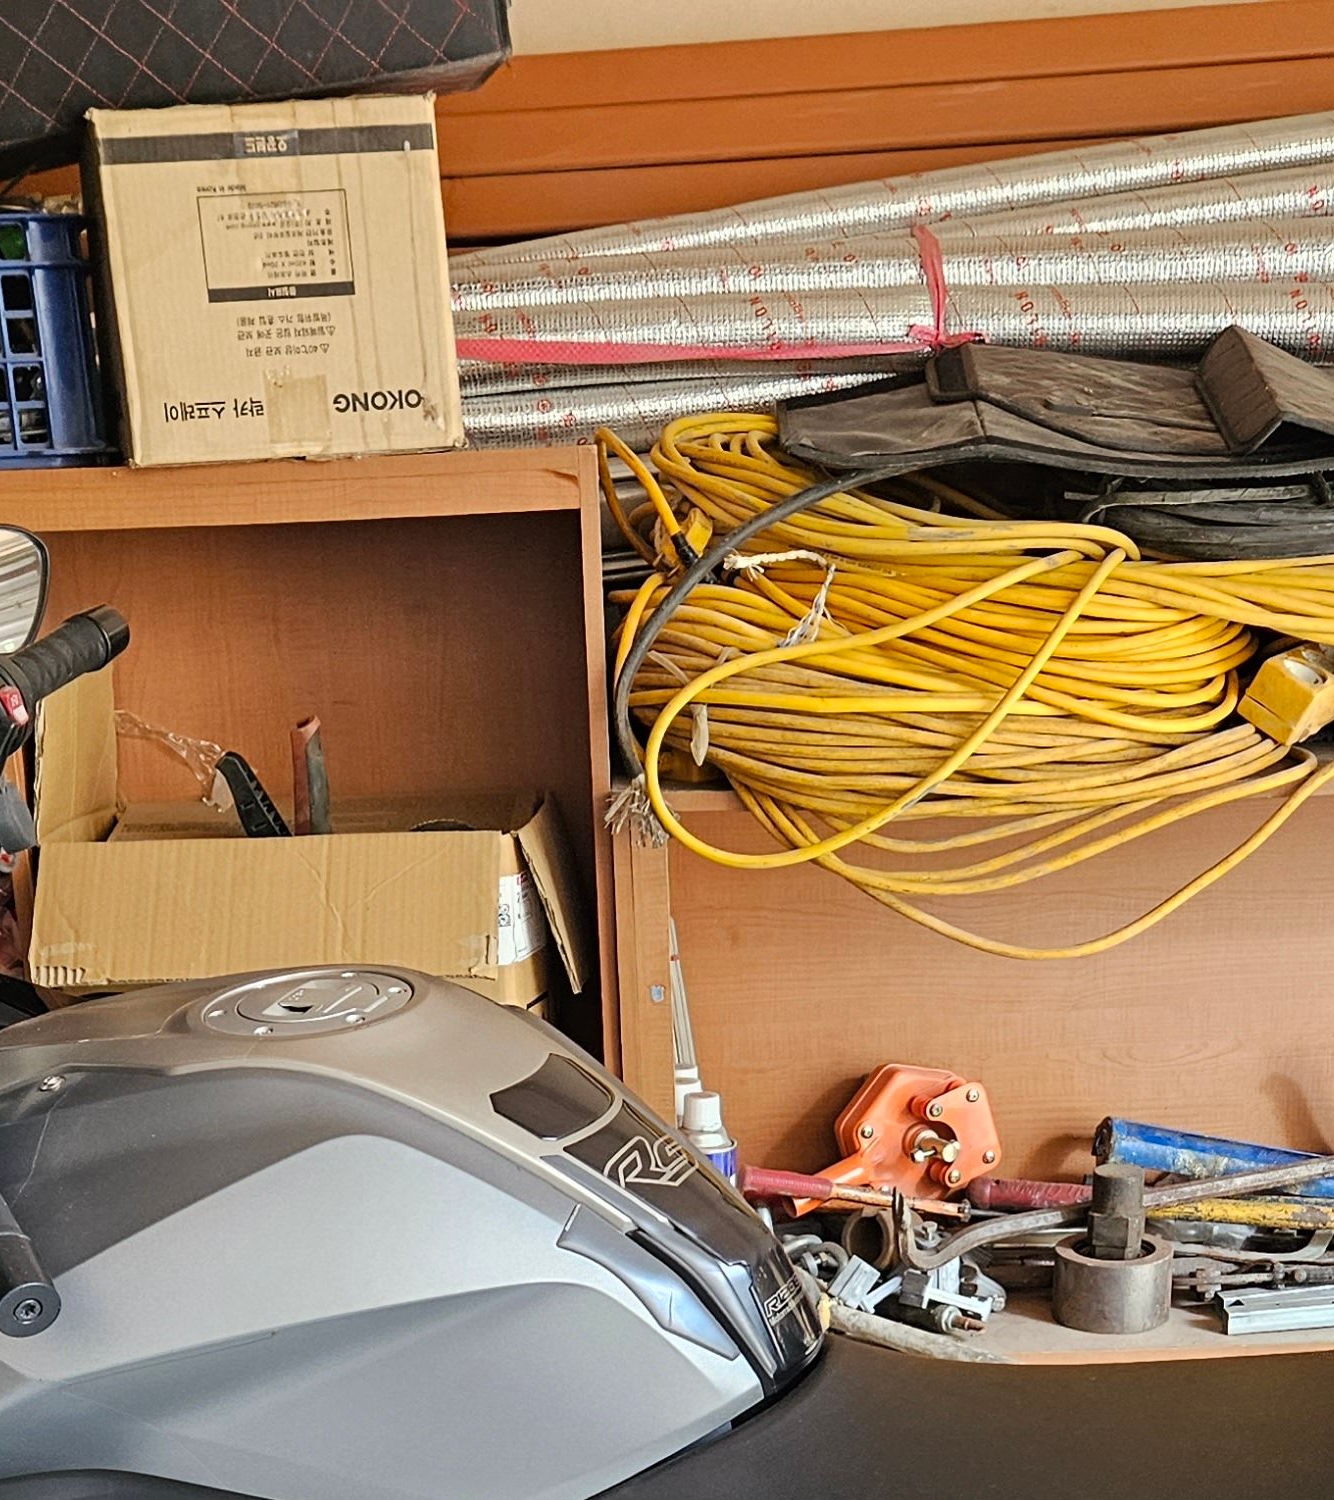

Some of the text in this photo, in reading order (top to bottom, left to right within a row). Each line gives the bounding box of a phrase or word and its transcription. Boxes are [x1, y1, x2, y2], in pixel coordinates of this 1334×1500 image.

[164, 397, 266, 424] 락카 스프레이
[333, 388, 422, 412] OKONG
[603, 1135, 699, 1188] RS
